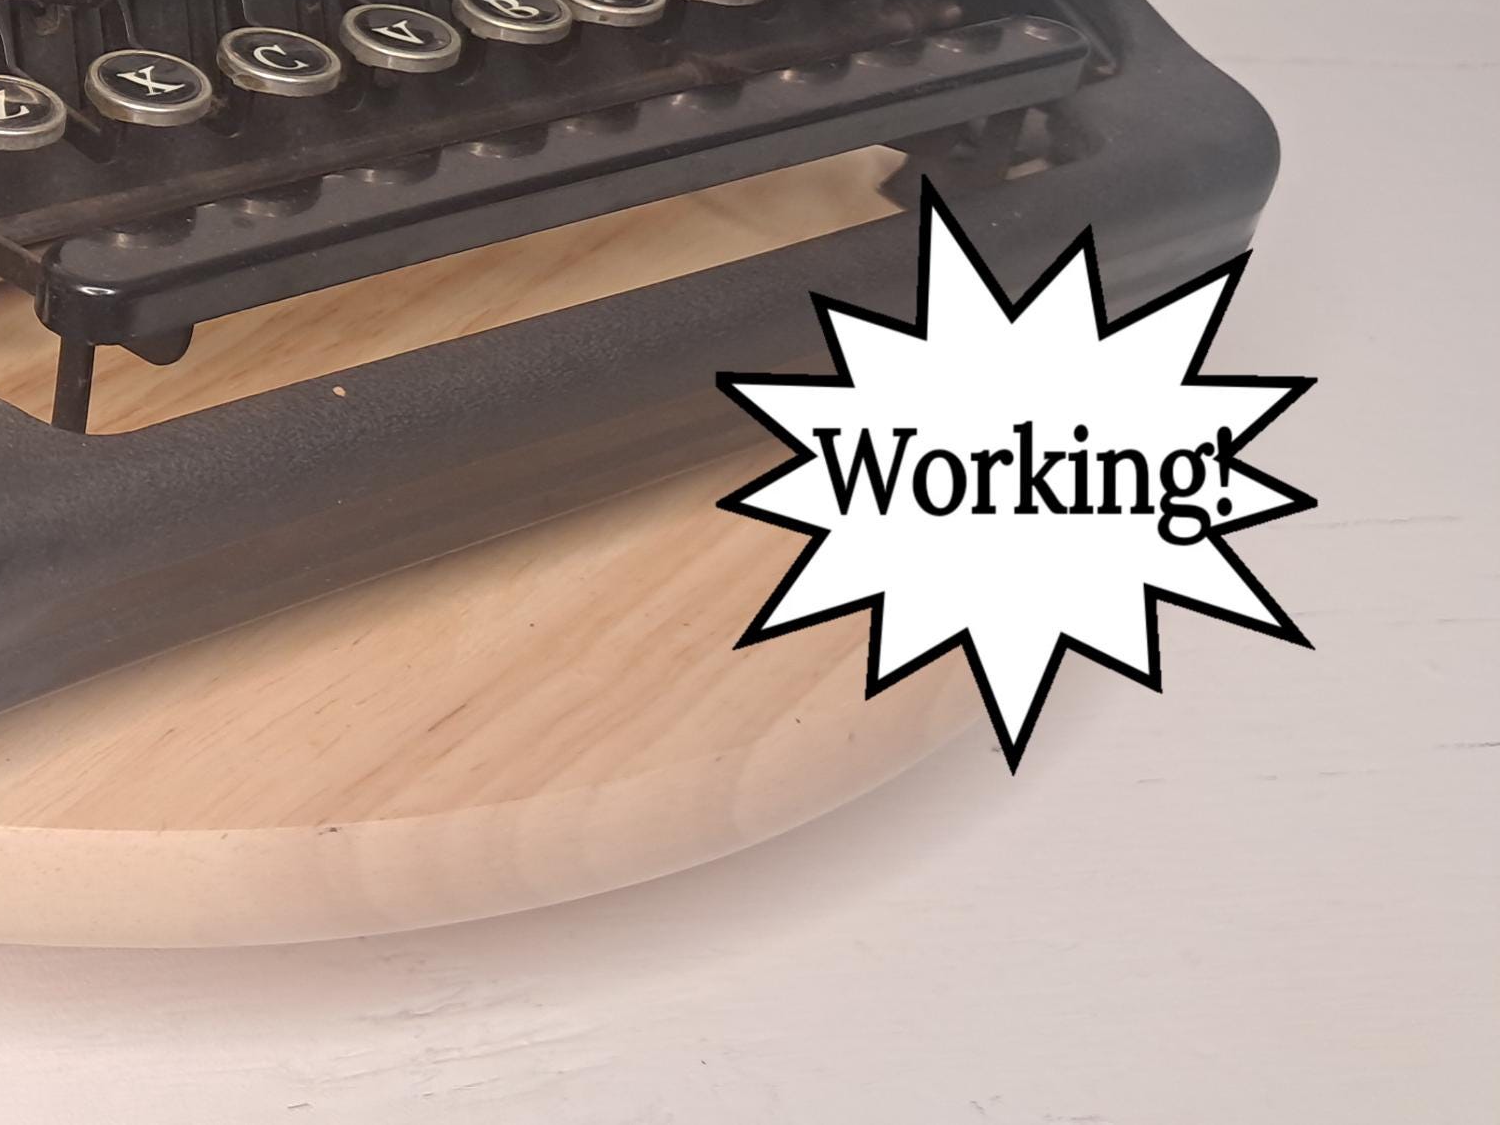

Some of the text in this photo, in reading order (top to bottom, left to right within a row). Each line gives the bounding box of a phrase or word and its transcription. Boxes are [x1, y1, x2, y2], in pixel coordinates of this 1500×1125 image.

[371, 20, 425, 45] V
[253, 44, 310, 70] C
[116, 65, 186, 97] X
